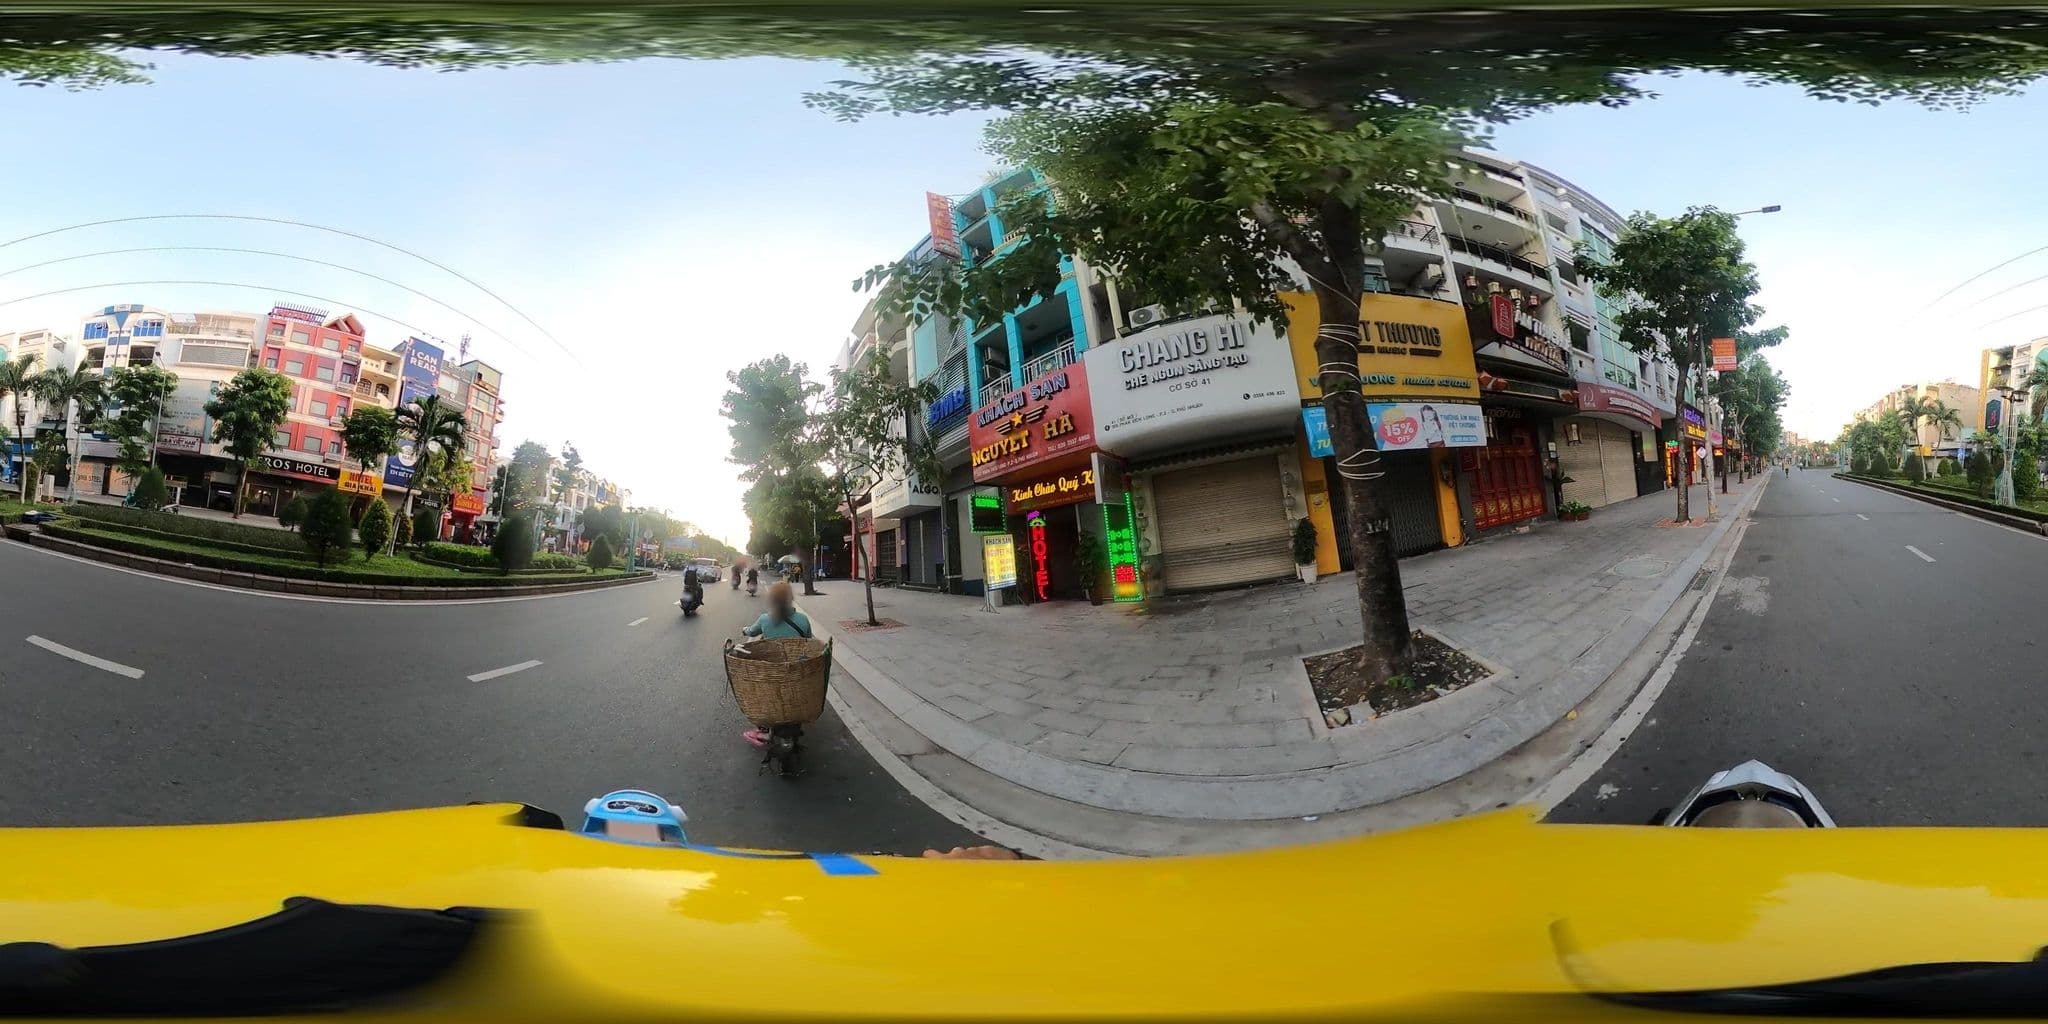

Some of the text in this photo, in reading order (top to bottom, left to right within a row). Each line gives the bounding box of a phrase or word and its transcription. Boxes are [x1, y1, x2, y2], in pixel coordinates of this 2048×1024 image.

[1120, 321, 1245, 372] CHANG HI
[416, 351, 438, 365] CAN
[1030, 373, 1068, 400] SẠN
[1168, 378, 1211, 392] CƠ SỞ 41
[1043, 410, 1074, 440] HÀ
[1384, 422, 1414, 436] 15%
[296, 463, 329, 477] HOTEL
[350, 472, 373, 483] HOTEL
[1032, 526, 1048, 600] HOTEL
